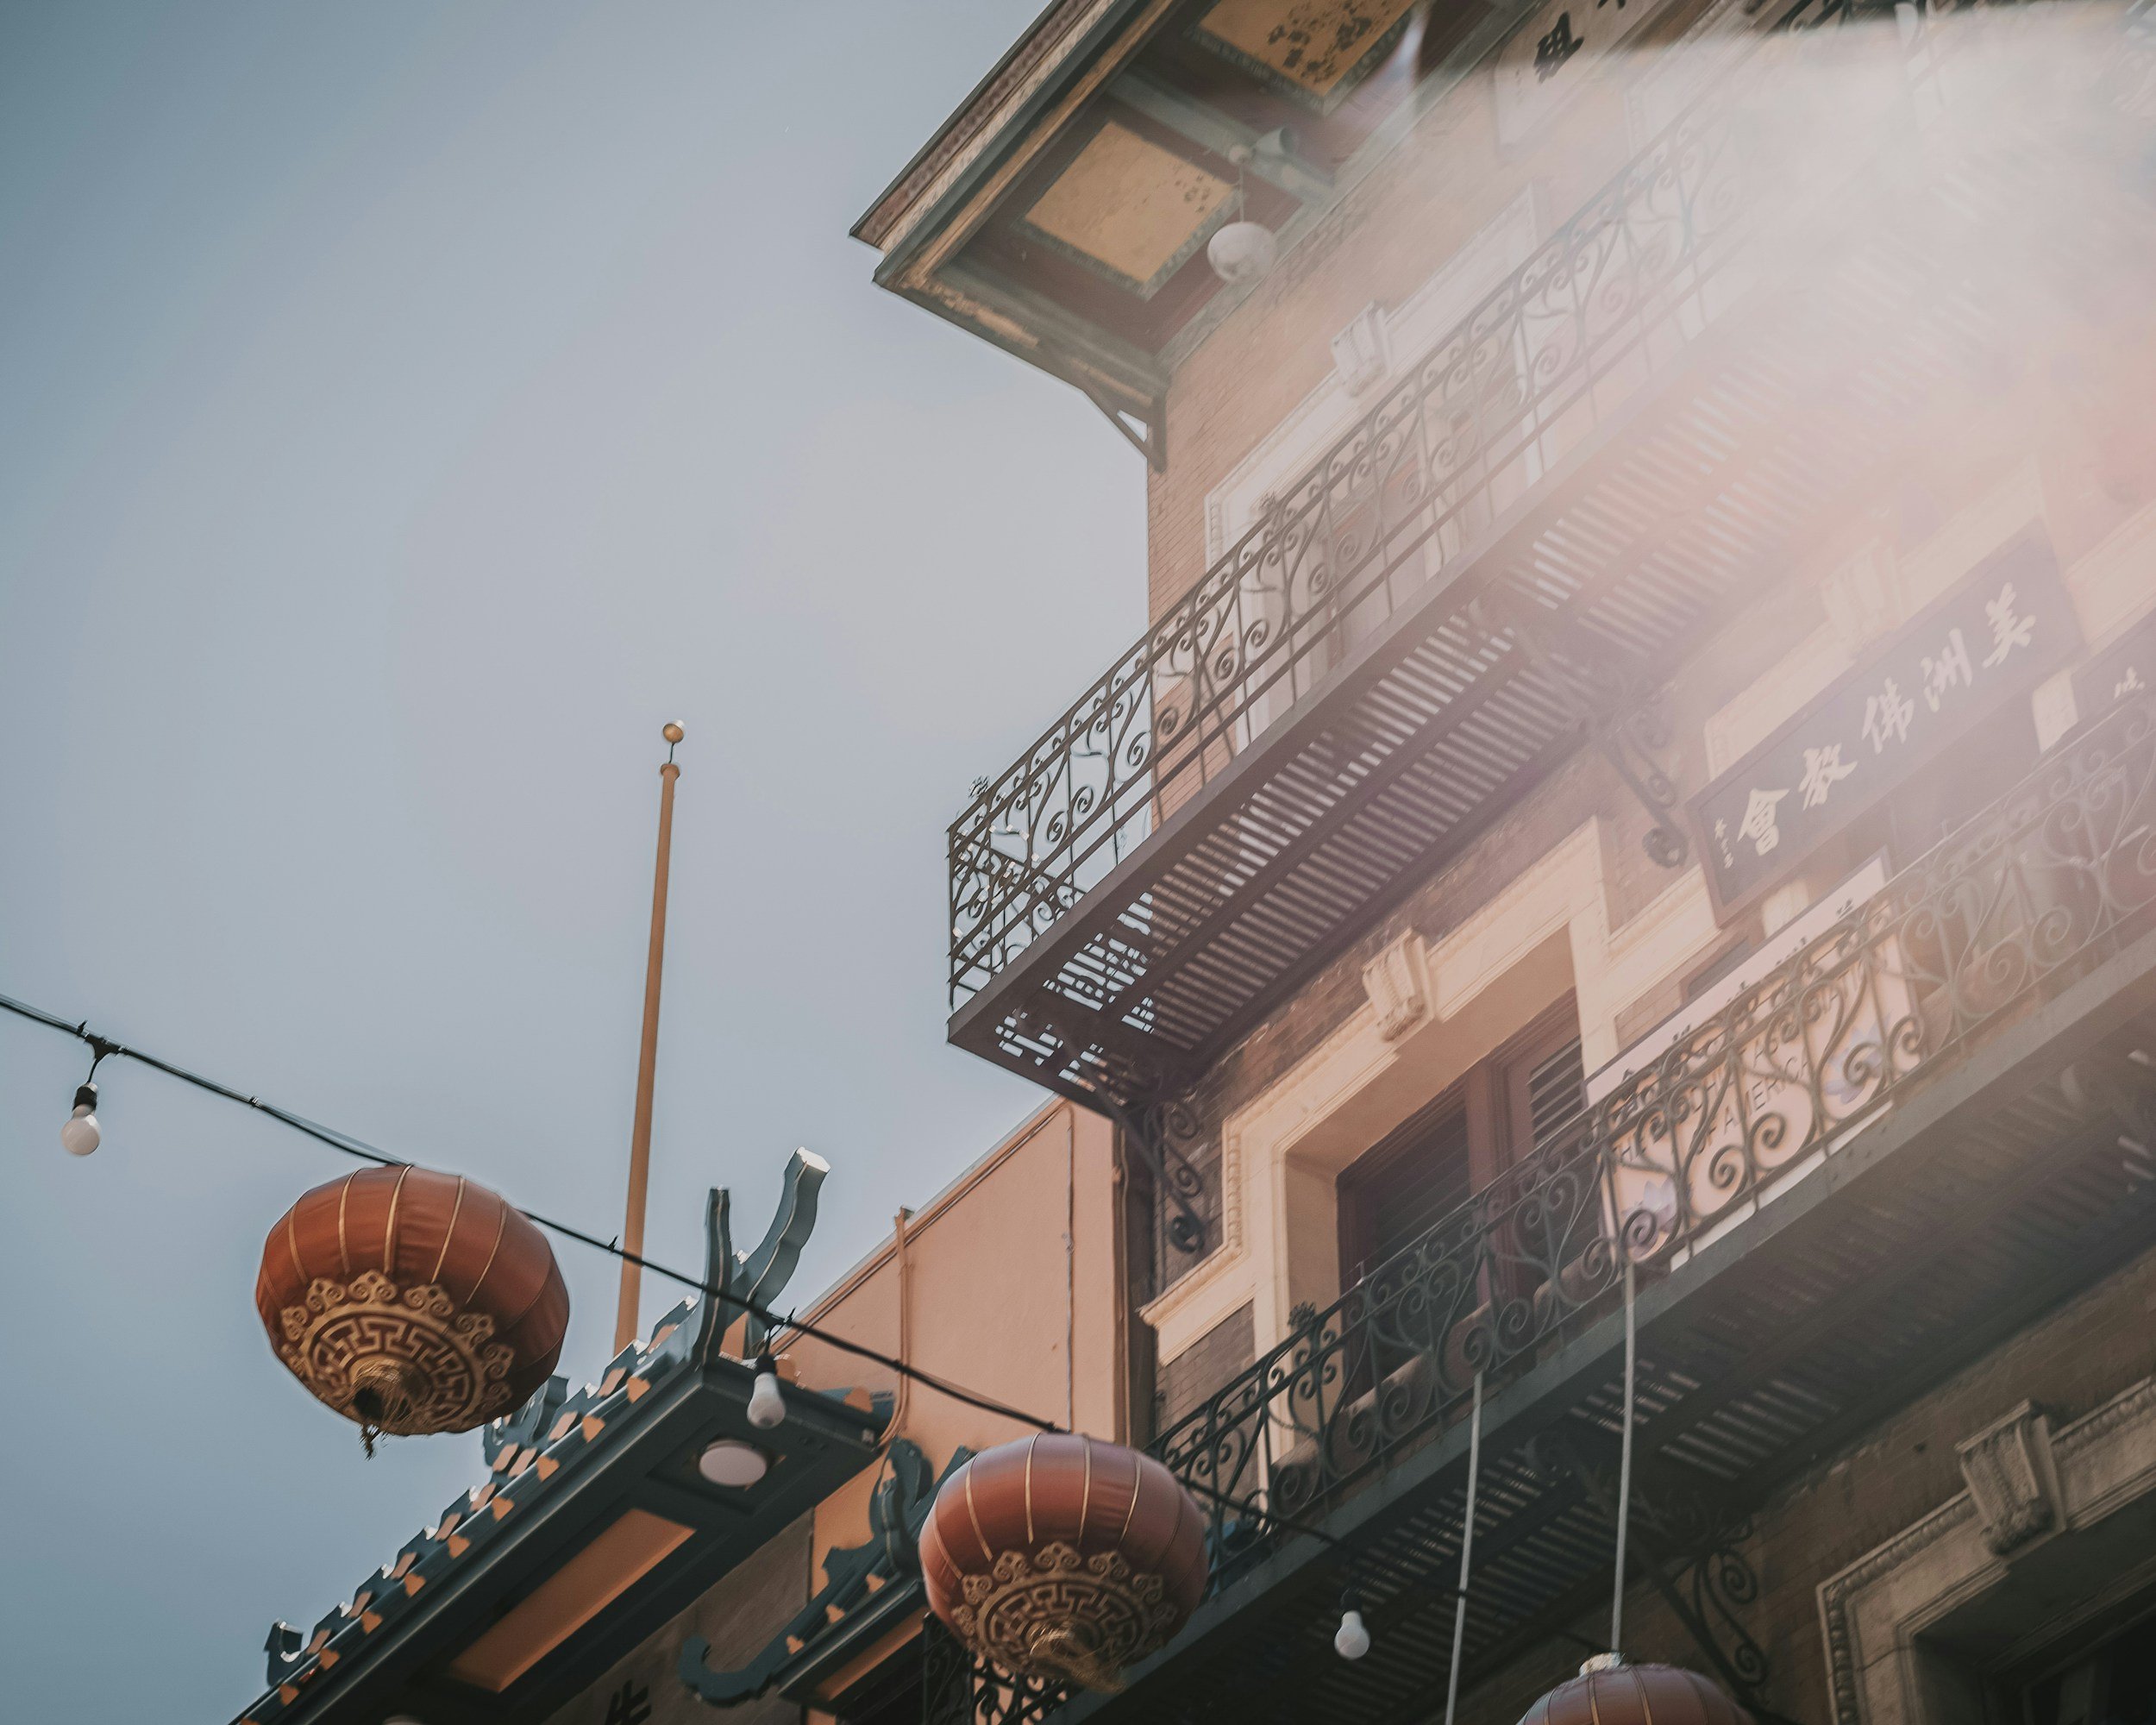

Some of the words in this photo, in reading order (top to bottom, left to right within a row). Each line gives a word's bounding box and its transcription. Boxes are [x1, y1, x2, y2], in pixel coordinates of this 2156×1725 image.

[1737, 581, 2037, 856] 美洲佛教會
